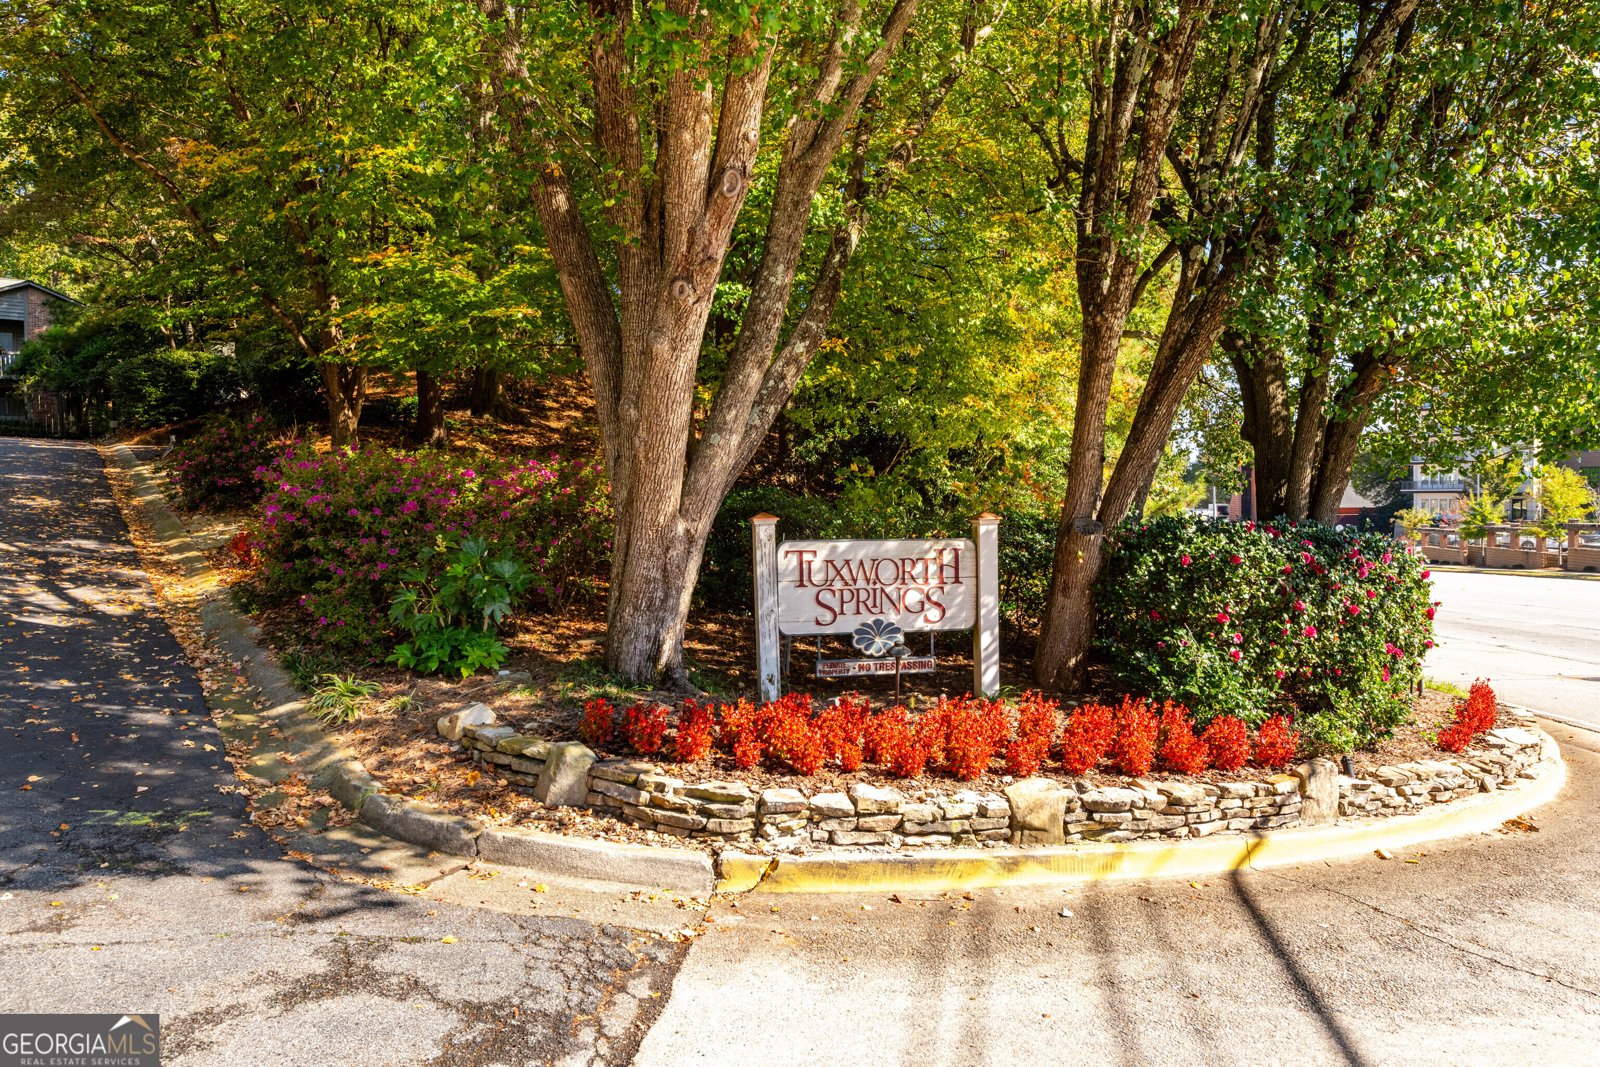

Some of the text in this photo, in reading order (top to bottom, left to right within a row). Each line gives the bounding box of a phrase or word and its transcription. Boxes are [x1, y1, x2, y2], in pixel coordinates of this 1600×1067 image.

[784, 548, 963, 588] TUXWORTH
[815, 586, 947, 626] SPRINGS
[857, 663, 871, 672] NO
[873, 660, 933, 671] TRESASSING
